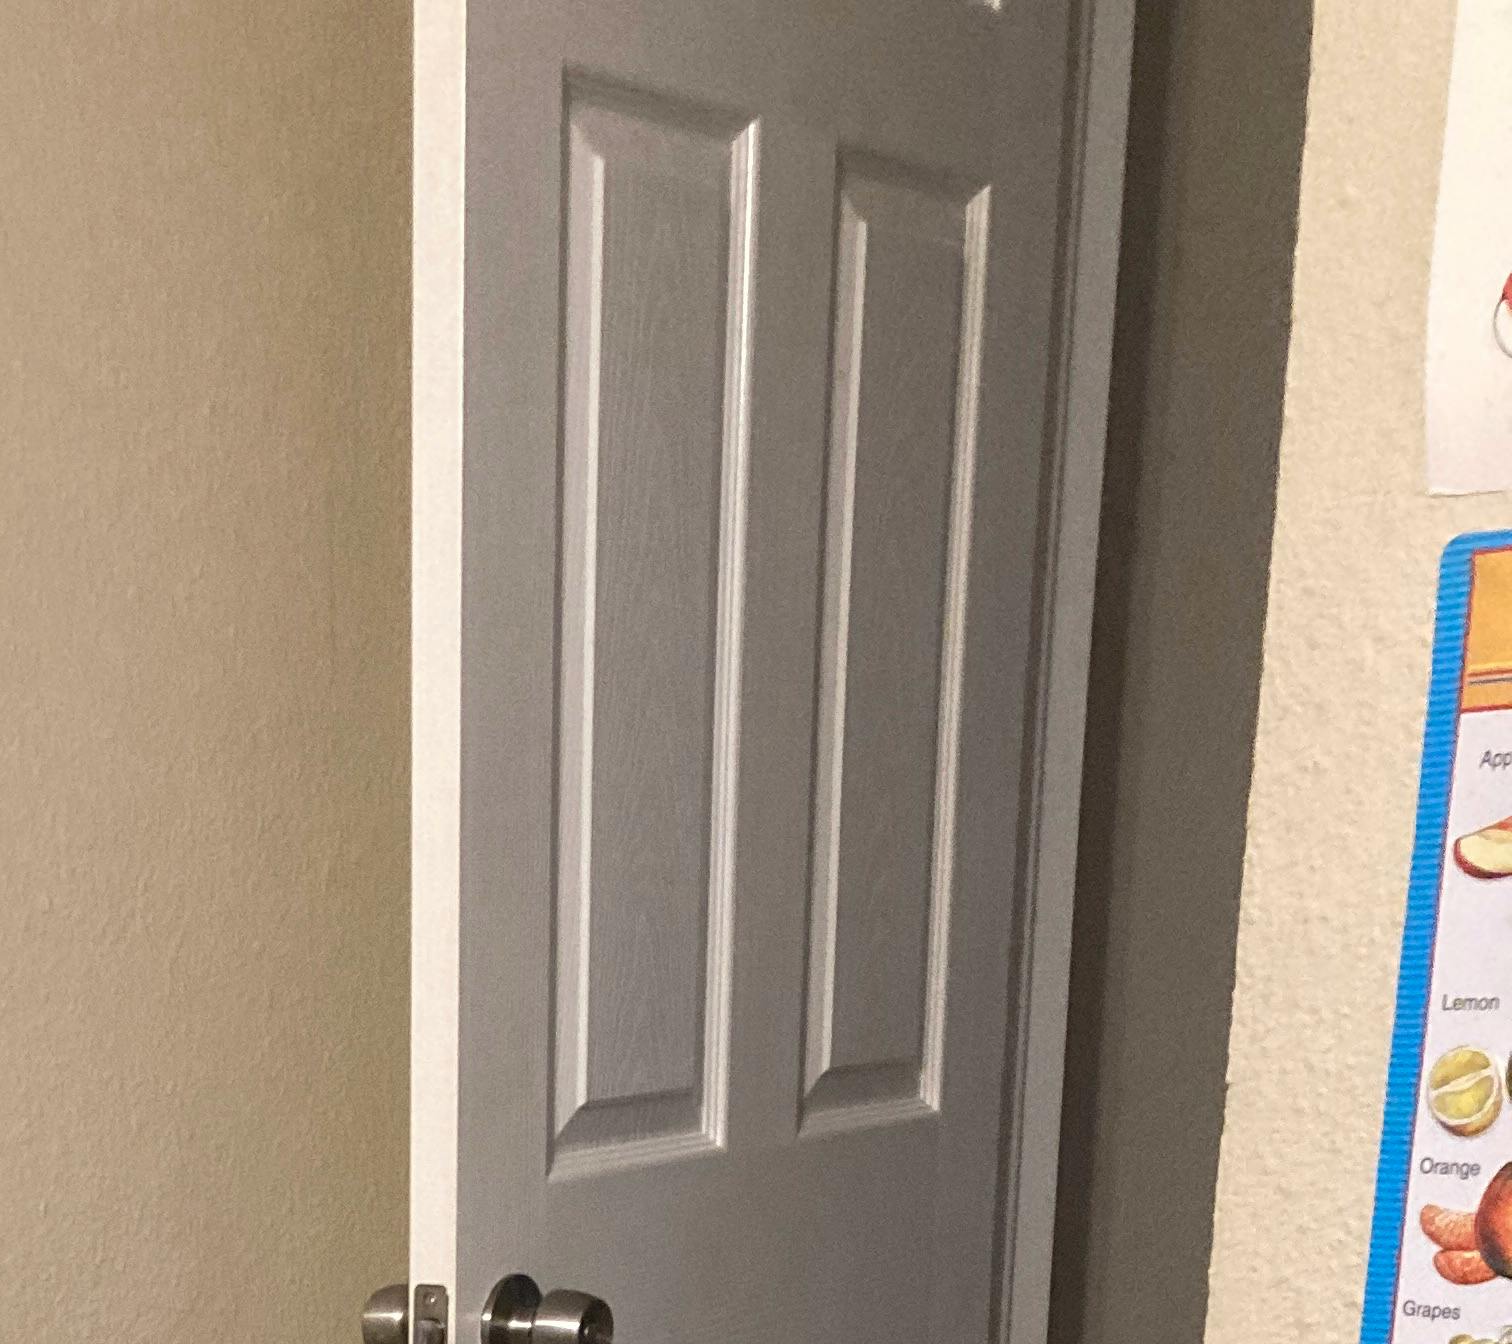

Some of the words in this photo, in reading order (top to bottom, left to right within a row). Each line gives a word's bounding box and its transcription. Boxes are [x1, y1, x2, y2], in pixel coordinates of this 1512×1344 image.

[1442, 993, 1501, 1012] Lemon
[1420, 1157, 1482, 1180] Orange
[1403, 1300, 1461, 1321] Grapes
